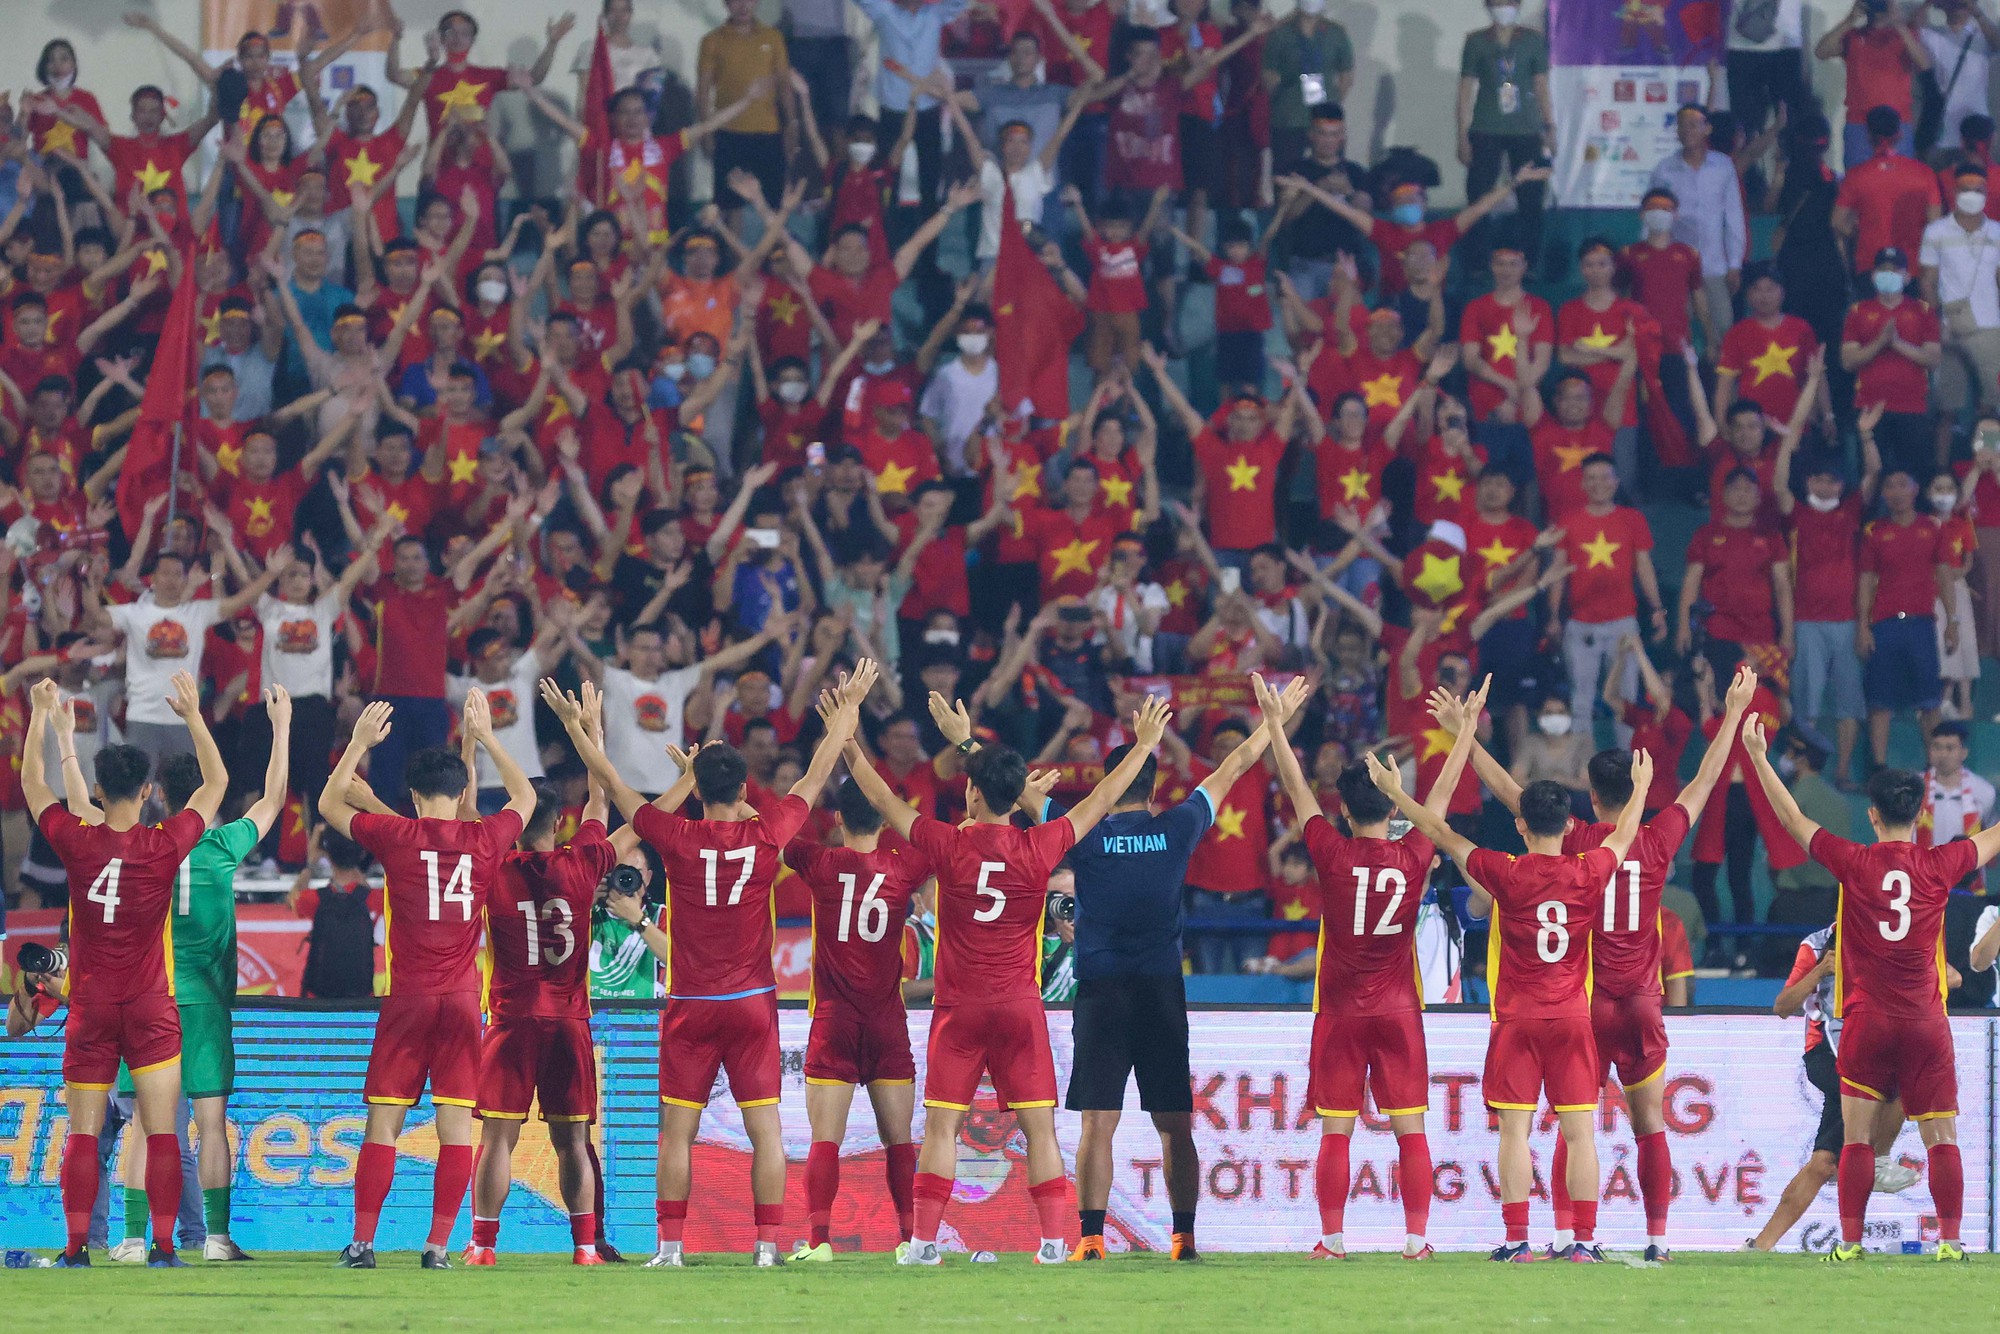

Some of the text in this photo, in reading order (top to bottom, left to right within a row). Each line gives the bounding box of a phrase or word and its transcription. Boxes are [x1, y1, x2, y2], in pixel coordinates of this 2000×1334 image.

[699, 845, 757, 907] 17
[1102, 833, 1168, 854] VIETNAM
[86, 857, 122, 924] 4
[419, 850, 475, 922] 14
[837, 872, 889, 943] 16
[972, 861, 1007, 923] 5
[1351, 866, 1408, 936] 12
[1602, 849, 1641, 933] 11
[1878, 869, 1912, 942] 3
[516, 897, 576, 966] 13
[1536, 899, 1570, 964] 8
[599, 988, 612, 997] SEA
[1131, 1145, 1262, 1200] TỜI
[1694, 1150, 1766, 1216] VỆ
